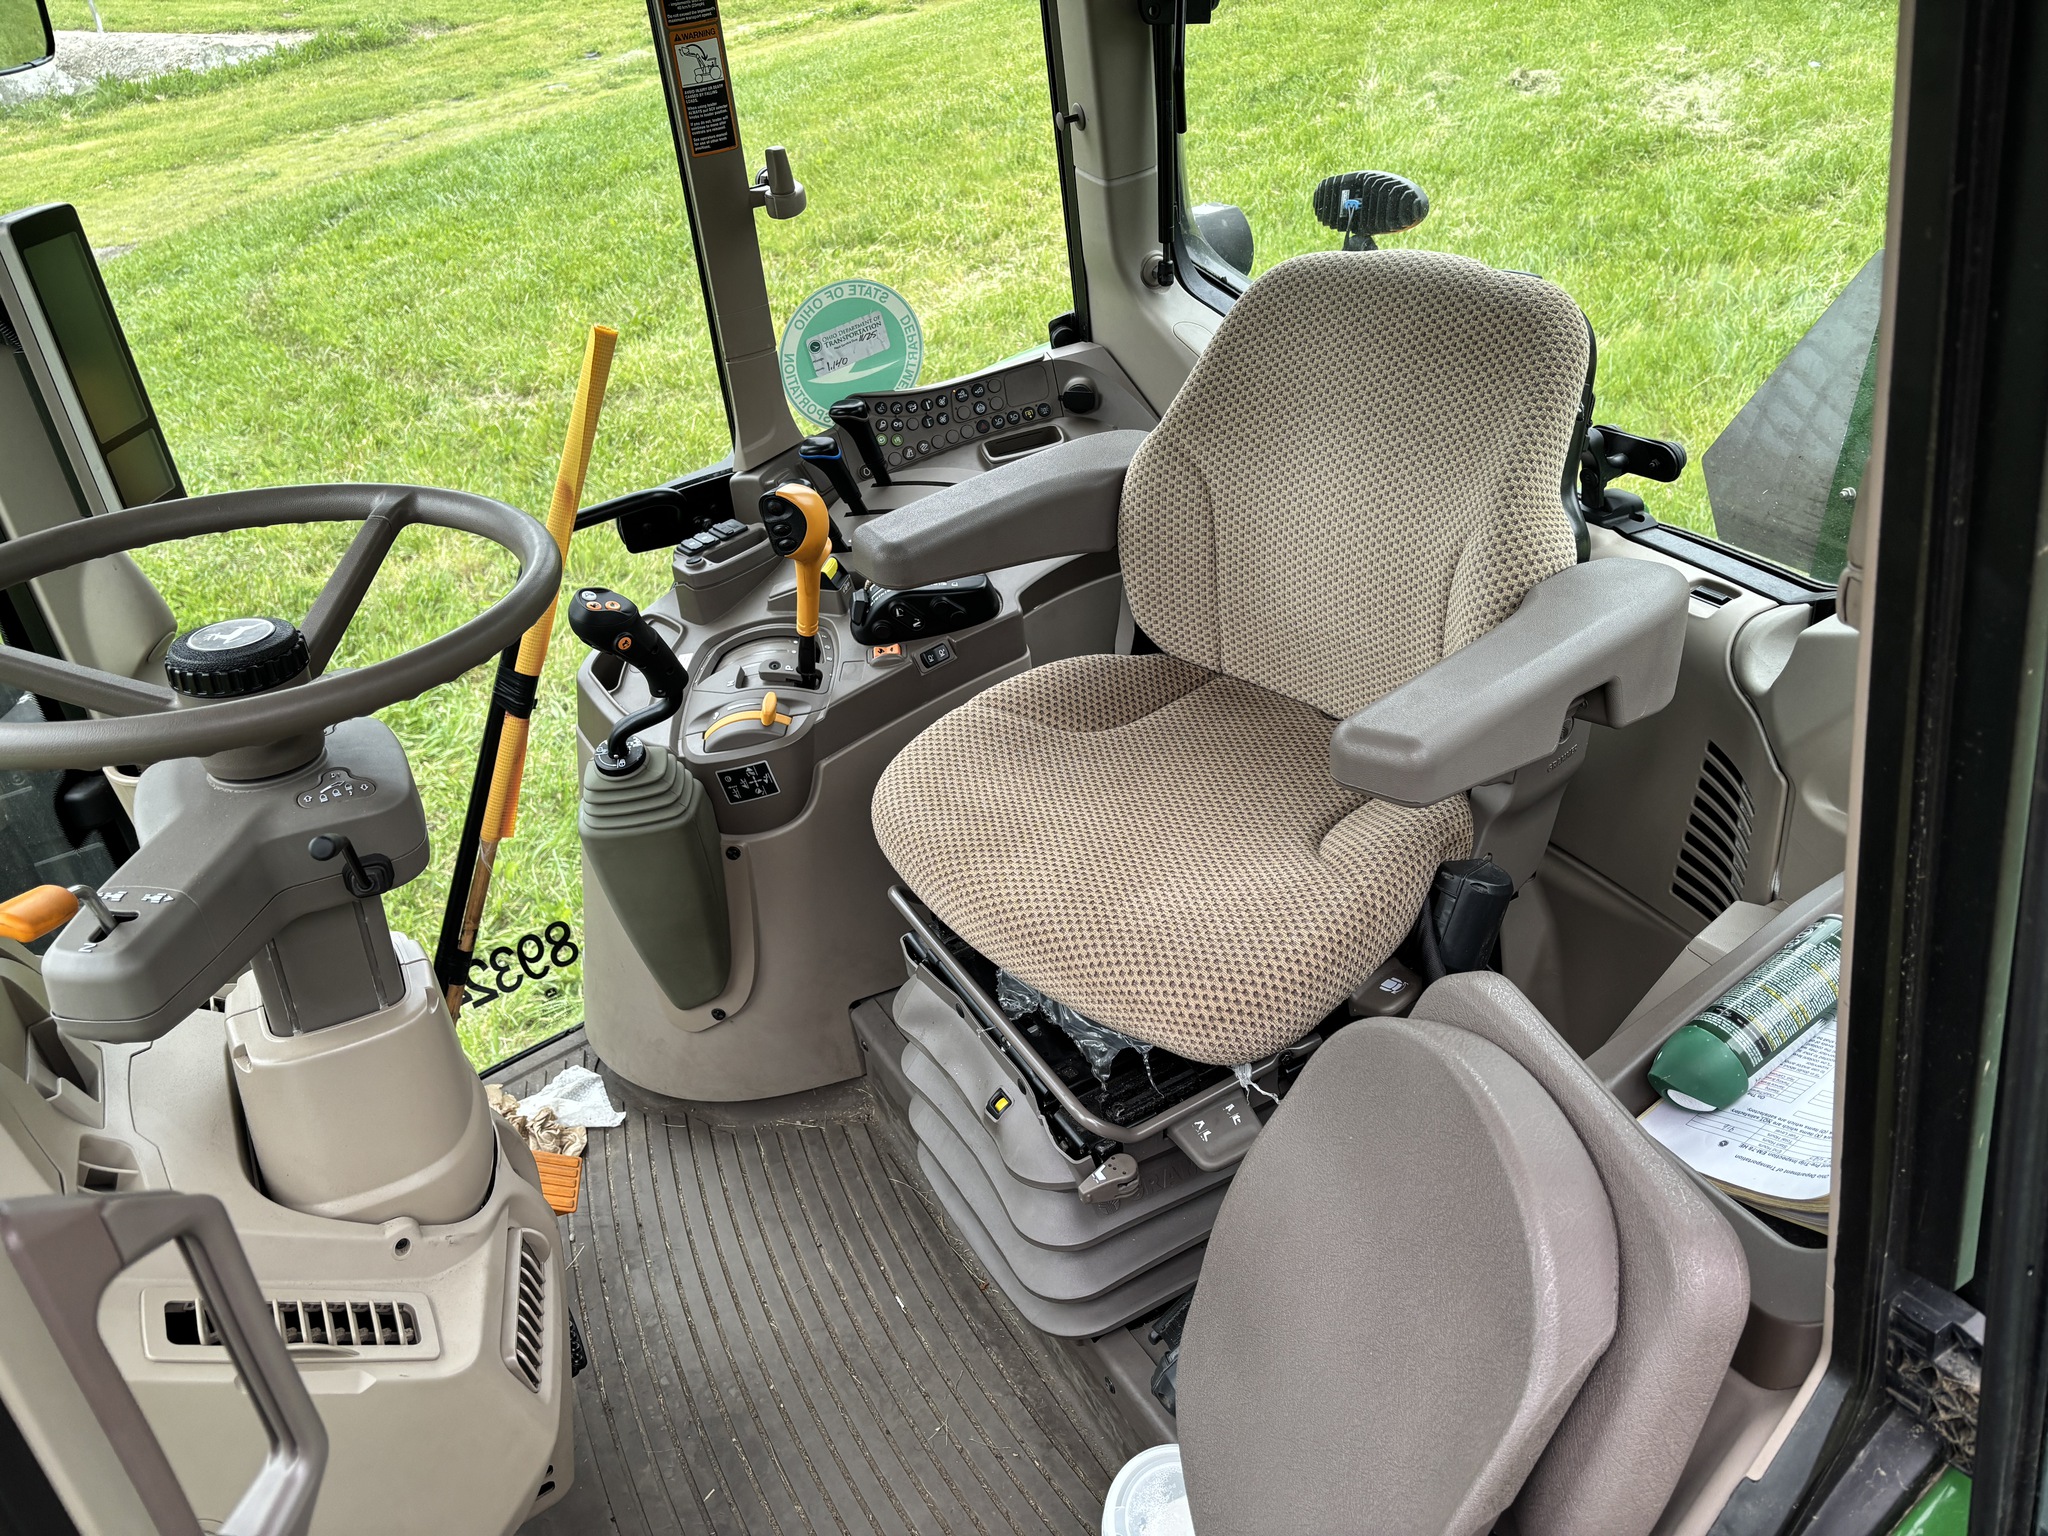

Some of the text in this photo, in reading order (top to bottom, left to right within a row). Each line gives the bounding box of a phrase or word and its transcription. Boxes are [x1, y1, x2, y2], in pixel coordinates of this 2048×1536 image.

[681, 28, 715, 40] WARNING
[824, 320, 882, 348] TRANSPORTATION
[1734, 1154, 1776, 1170] Transportation
[1767, 1152, 1797, 1164] Inspection
